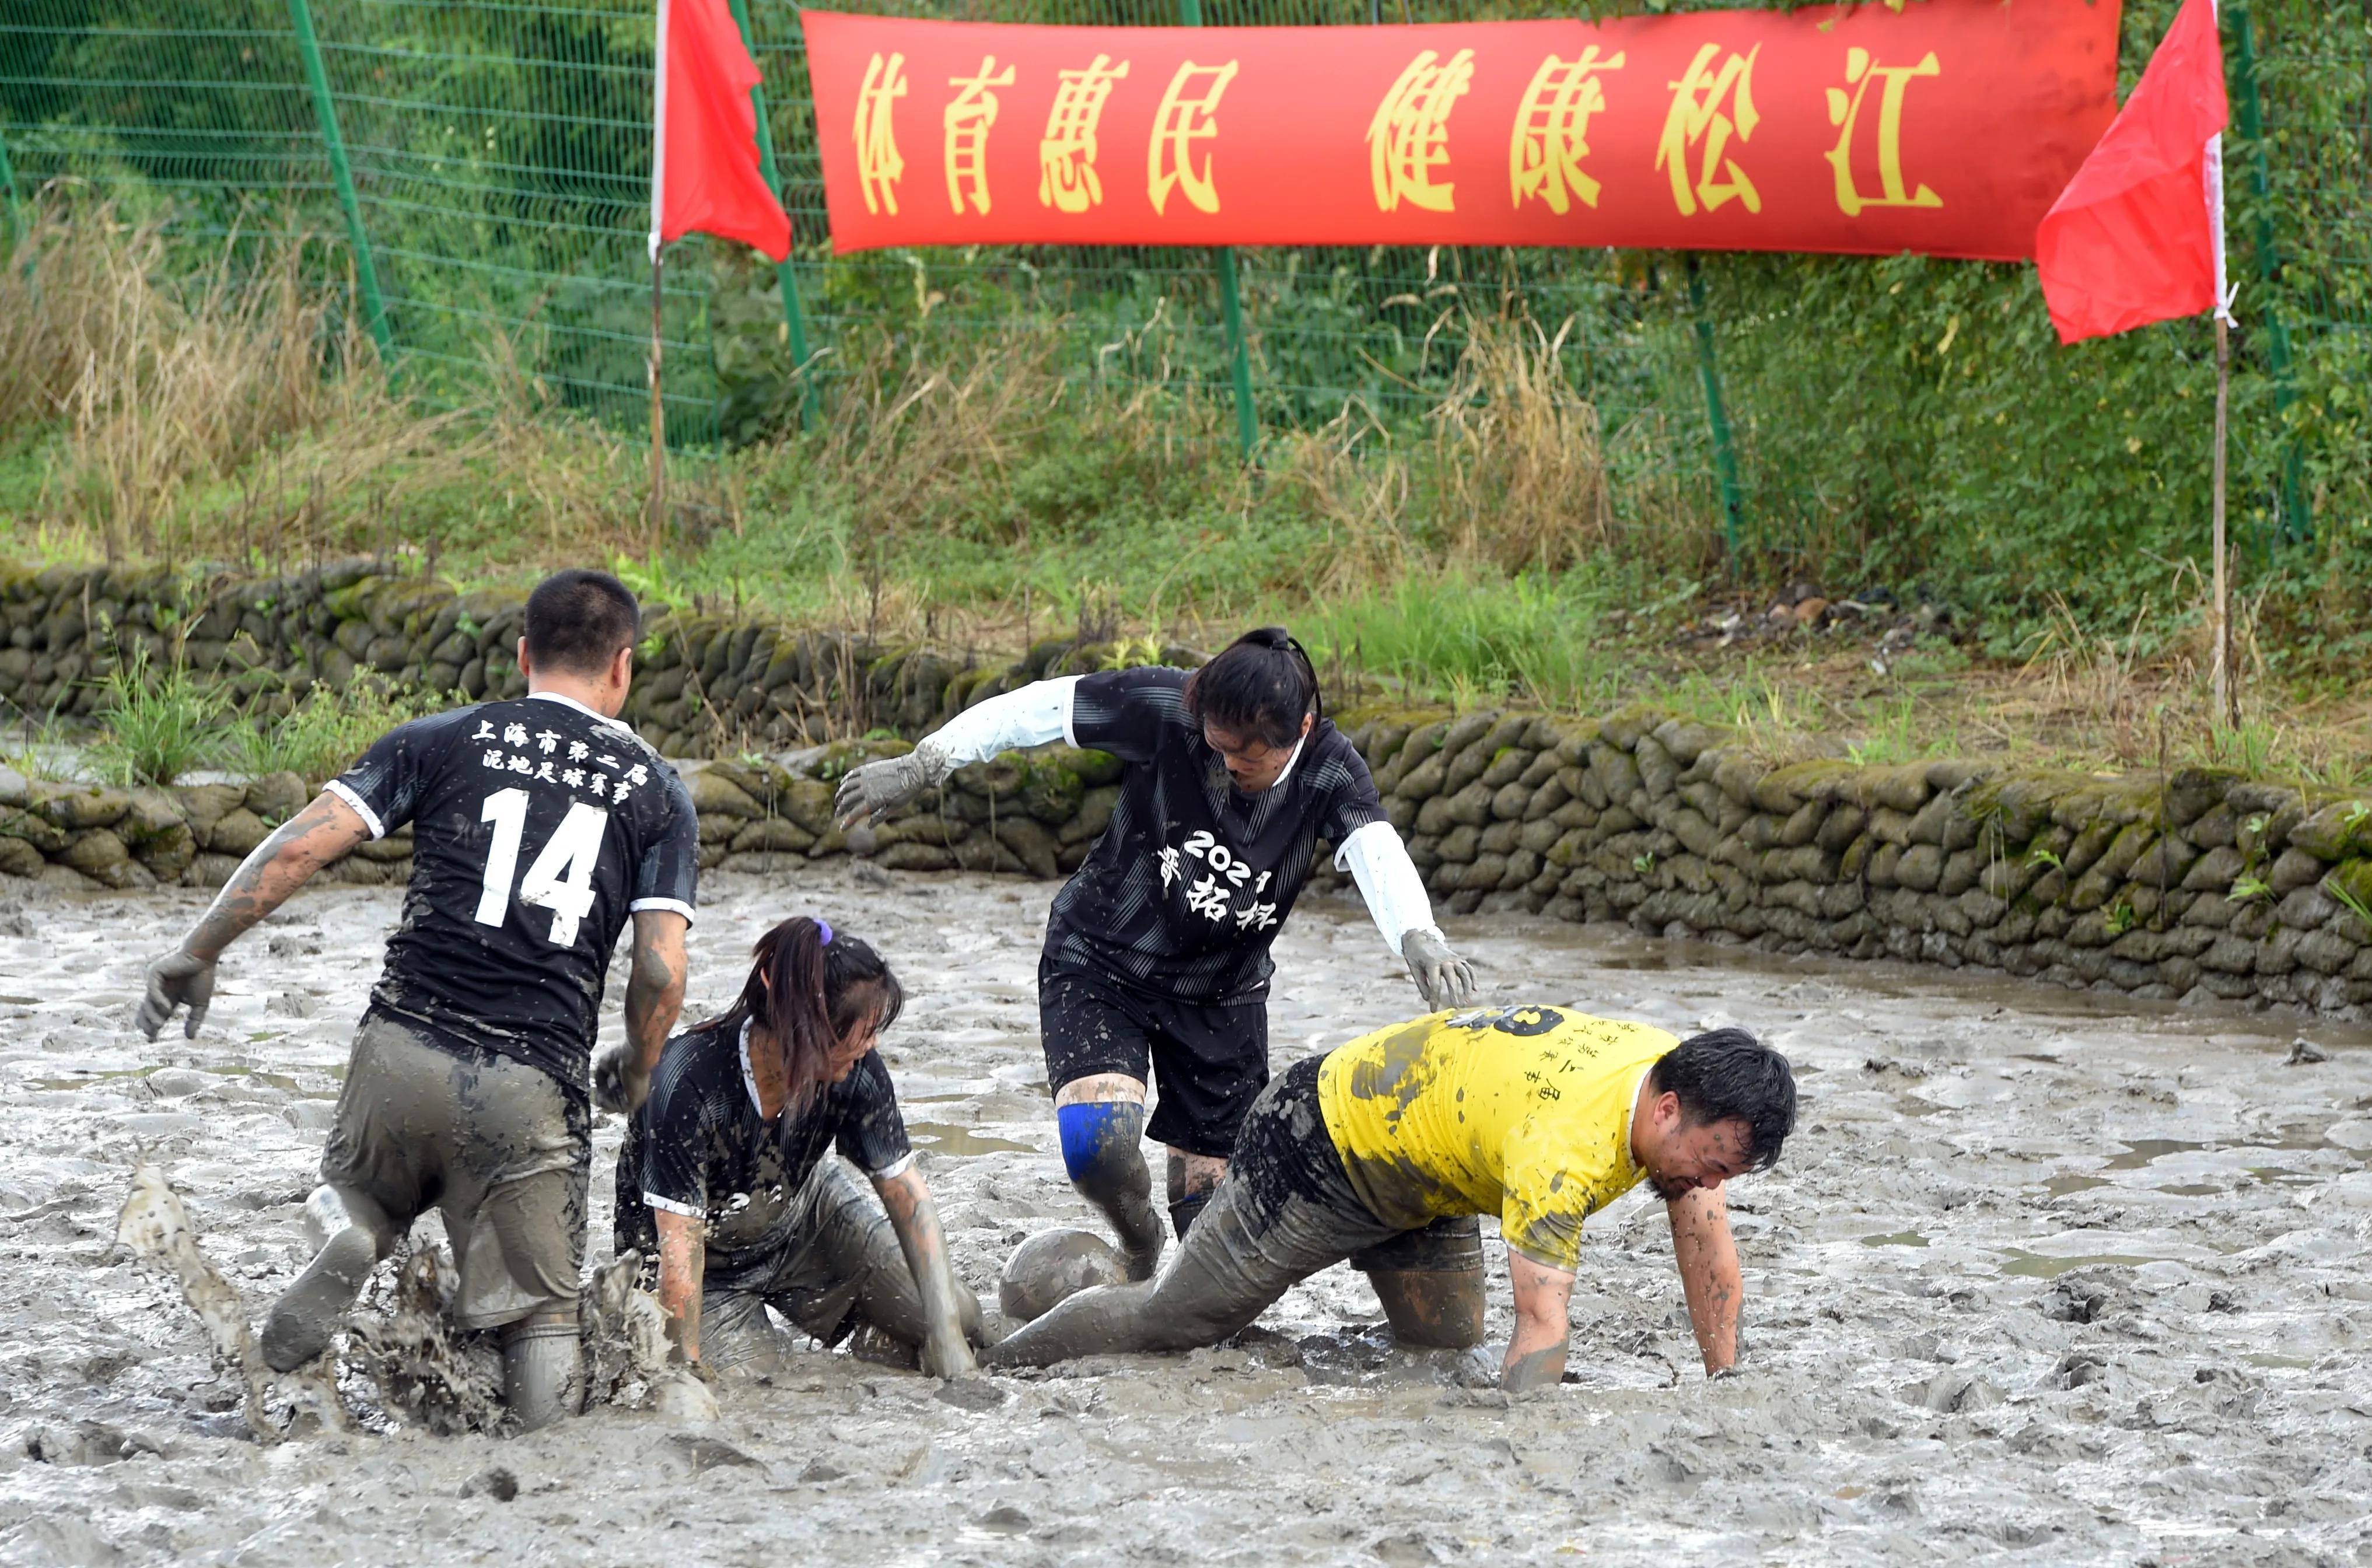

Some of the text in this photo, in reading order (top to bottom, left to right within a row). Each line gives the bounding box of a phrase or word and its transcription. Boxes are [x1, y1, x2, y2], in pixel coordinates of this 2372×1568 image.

[852, 42, 1943, 216] 体育惠民 健康松江
[471, 719, 648, 786] 上海市第二届
[482, 748, 632, 805] 泥地足球赛事
[474, 787, 608, 949] 14
[1184, 830, 1272, 894] 2021
